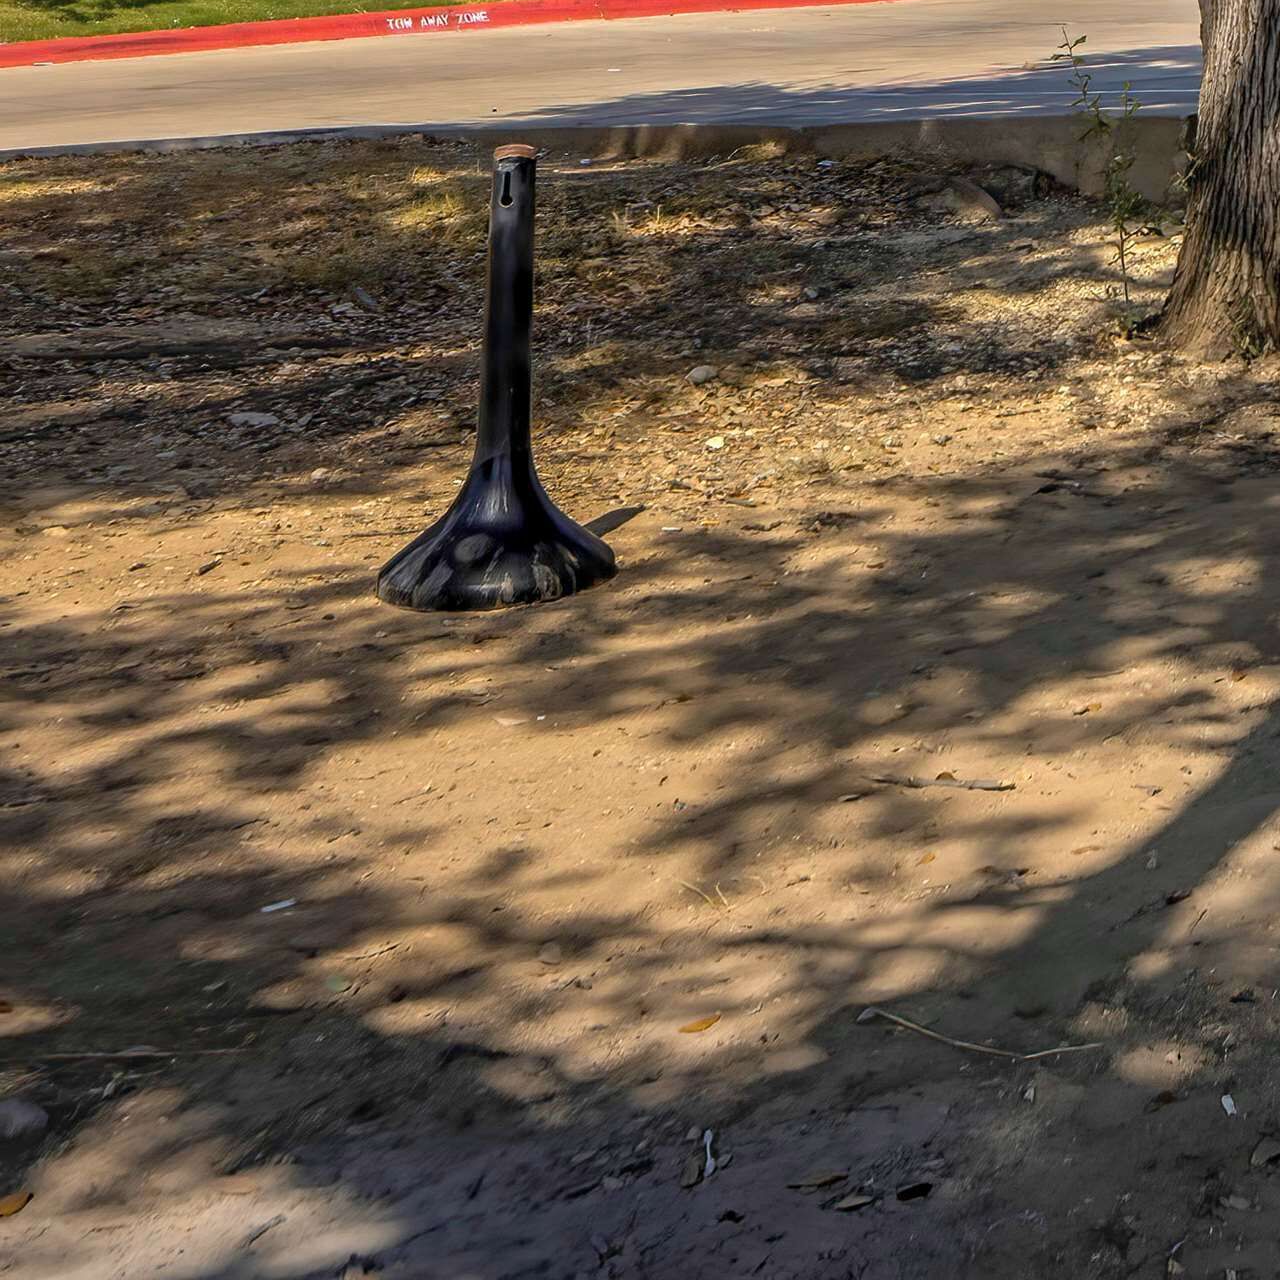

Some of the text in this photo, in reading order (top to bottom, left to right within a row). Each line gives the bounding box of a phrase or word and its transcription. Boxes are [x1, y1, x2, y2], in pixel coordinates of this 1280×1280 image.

[386, 11, 490, 30] TOW AWAY ZONE
